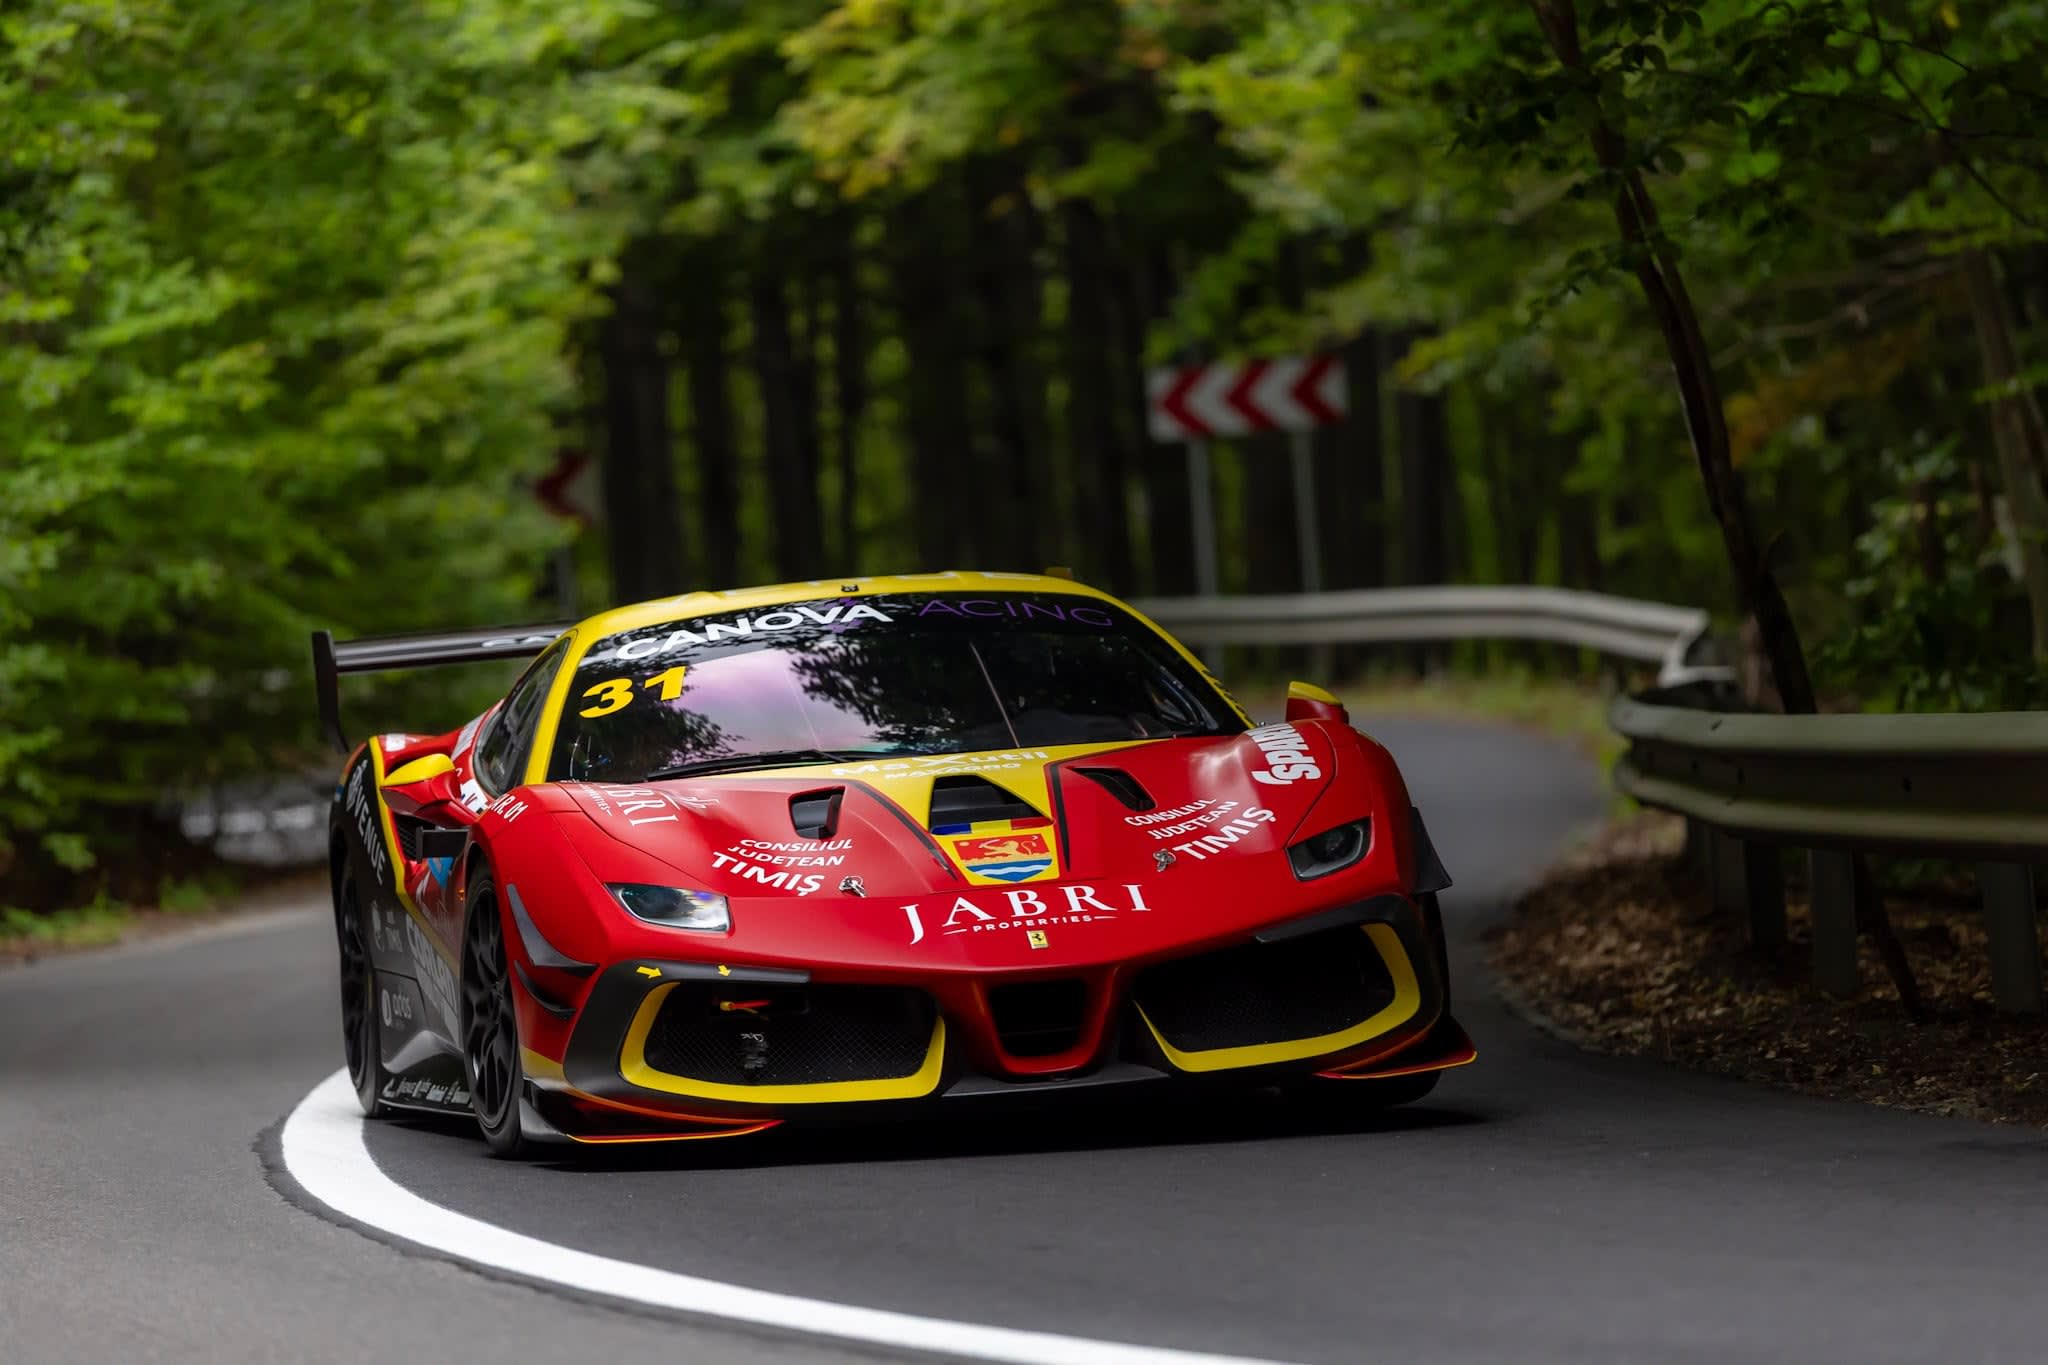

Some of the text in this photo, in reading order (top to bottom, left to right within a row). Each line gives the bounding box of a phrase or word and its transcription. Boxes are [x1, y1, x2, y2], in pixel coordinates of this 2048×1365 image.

[616, 604, 894, 660] CANOVA
[579, 666, 686, 719] 31
[1124, 799, 1217, 826] CONSILIUL
[1172, 807, 1277, 860] TIMIȘ
[739, 838, 853, 852] CONSILIUL
[711, 851, 825, 896] TIMIȘ
[899, 884, 1152, 945] JABRI
[972, 914, 1092, 933] PROPERTIES
